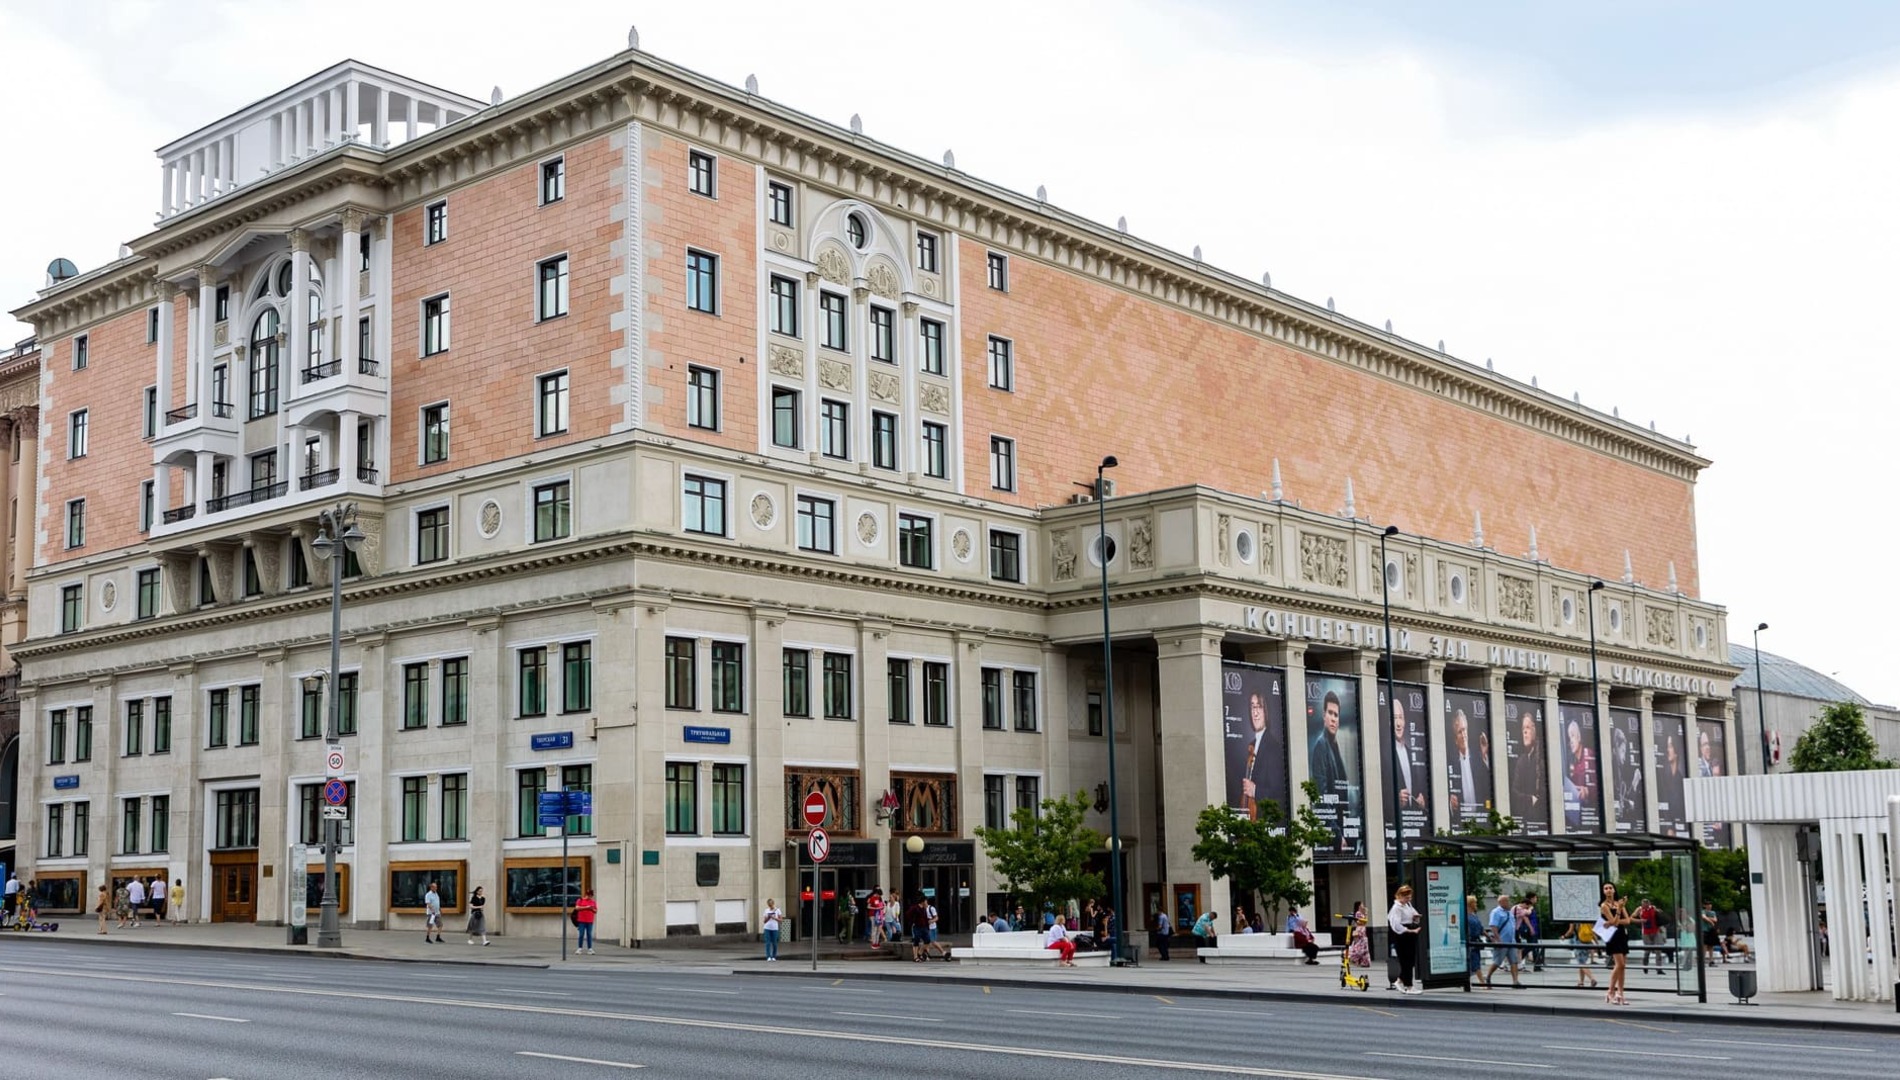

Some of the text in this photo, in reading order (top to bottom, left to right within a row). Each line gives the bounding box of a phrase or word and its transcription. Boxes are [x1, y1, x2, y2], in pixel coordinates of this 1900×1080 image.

[1245, 606, 1411, 651] КОНЦЕРТНЫЙ
[1429, 636, 1469, 659] ЗАЛ
[1487, 645, 1551, 673] ИМЕНИ
[1611, 664, 1717, 697] ЧАЙКОВСКОГО
[562, 736, 569, 744] 31
[331, 757, 341, 765] 50
[882, 788, 900, 809] М
